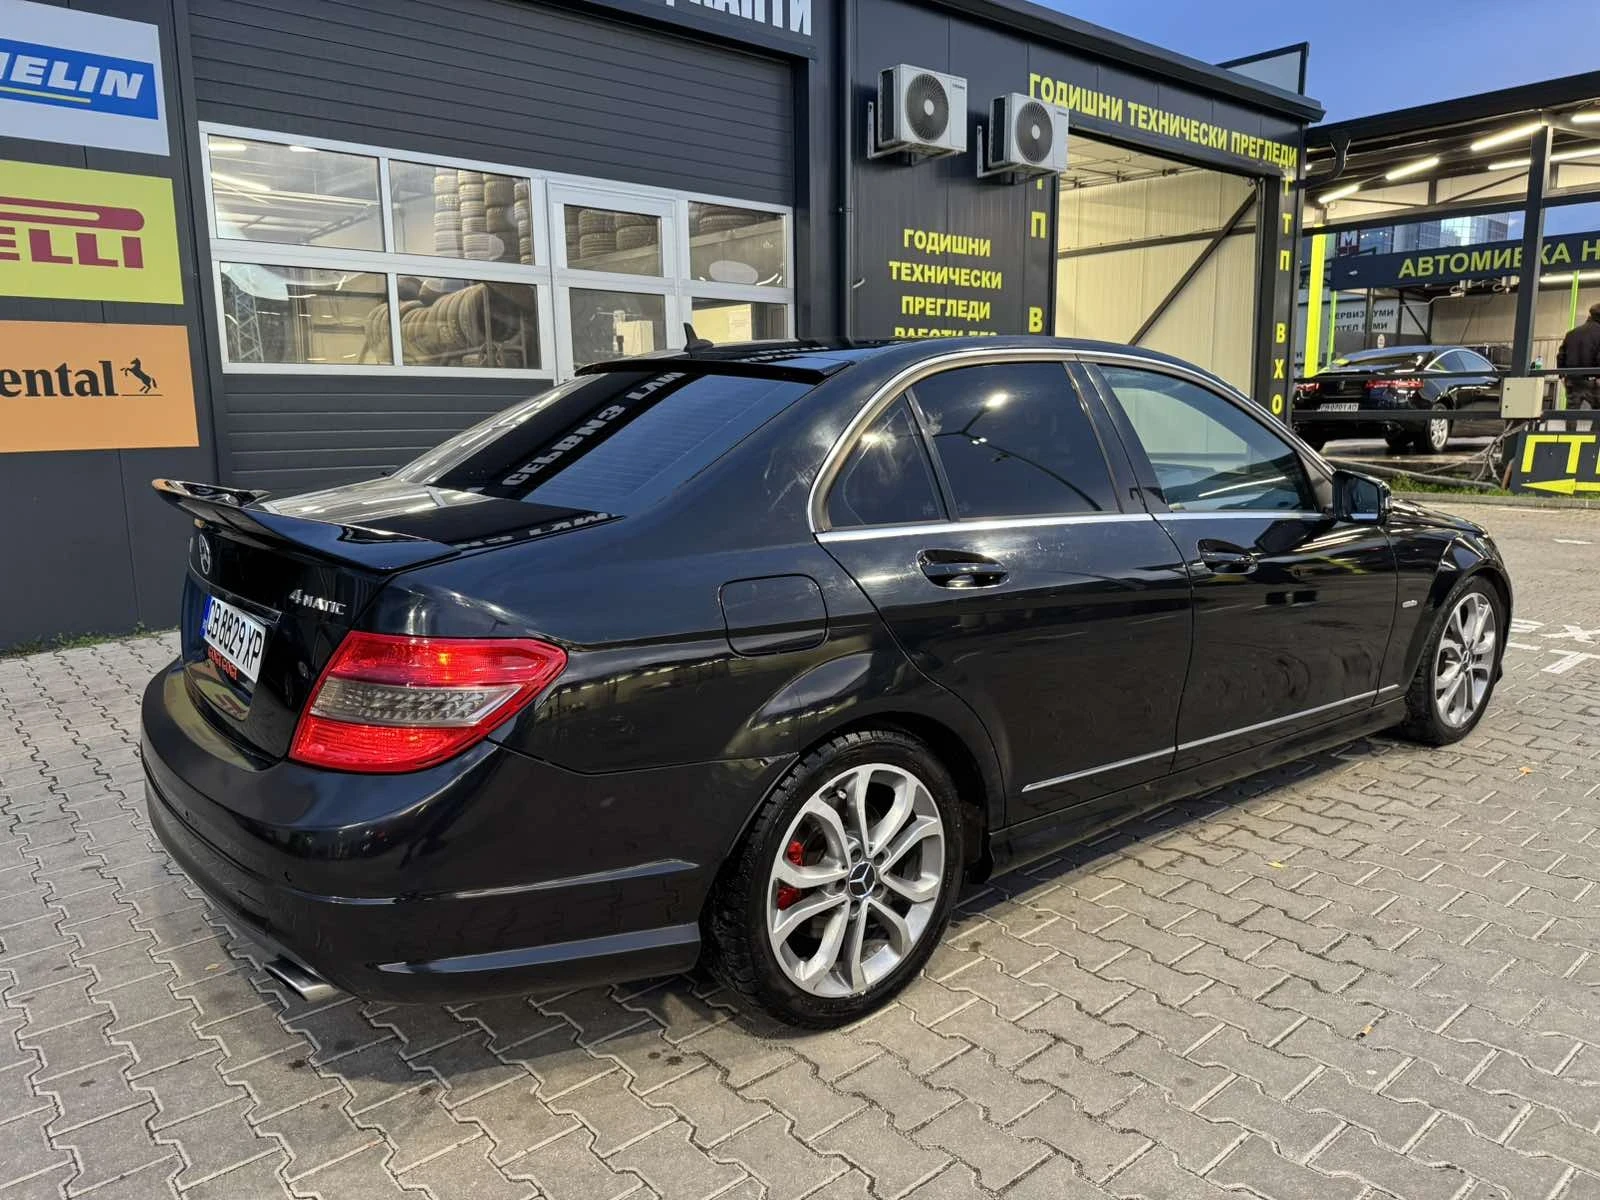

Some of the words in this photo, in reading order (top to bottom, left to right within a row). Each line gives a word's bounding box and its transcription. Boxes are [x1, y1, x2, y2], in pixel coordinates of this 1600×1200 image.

[1029, 73, 1123, 123] ГОДИШНИ
[1128, 101, 1227, 151] ТЕХНИЧЕСКИ
[1231, 132, 1297, 168] ПРЕГЛЕДИ
[904, 228, 991, 256] ГОДИШНИ
[888, 260, 1002, 289] ТЕХНИЧЕСКИ
[901, 295, 991, 321] ПРЕГЛЕДИ
[0, 360, 118, 397] ental
